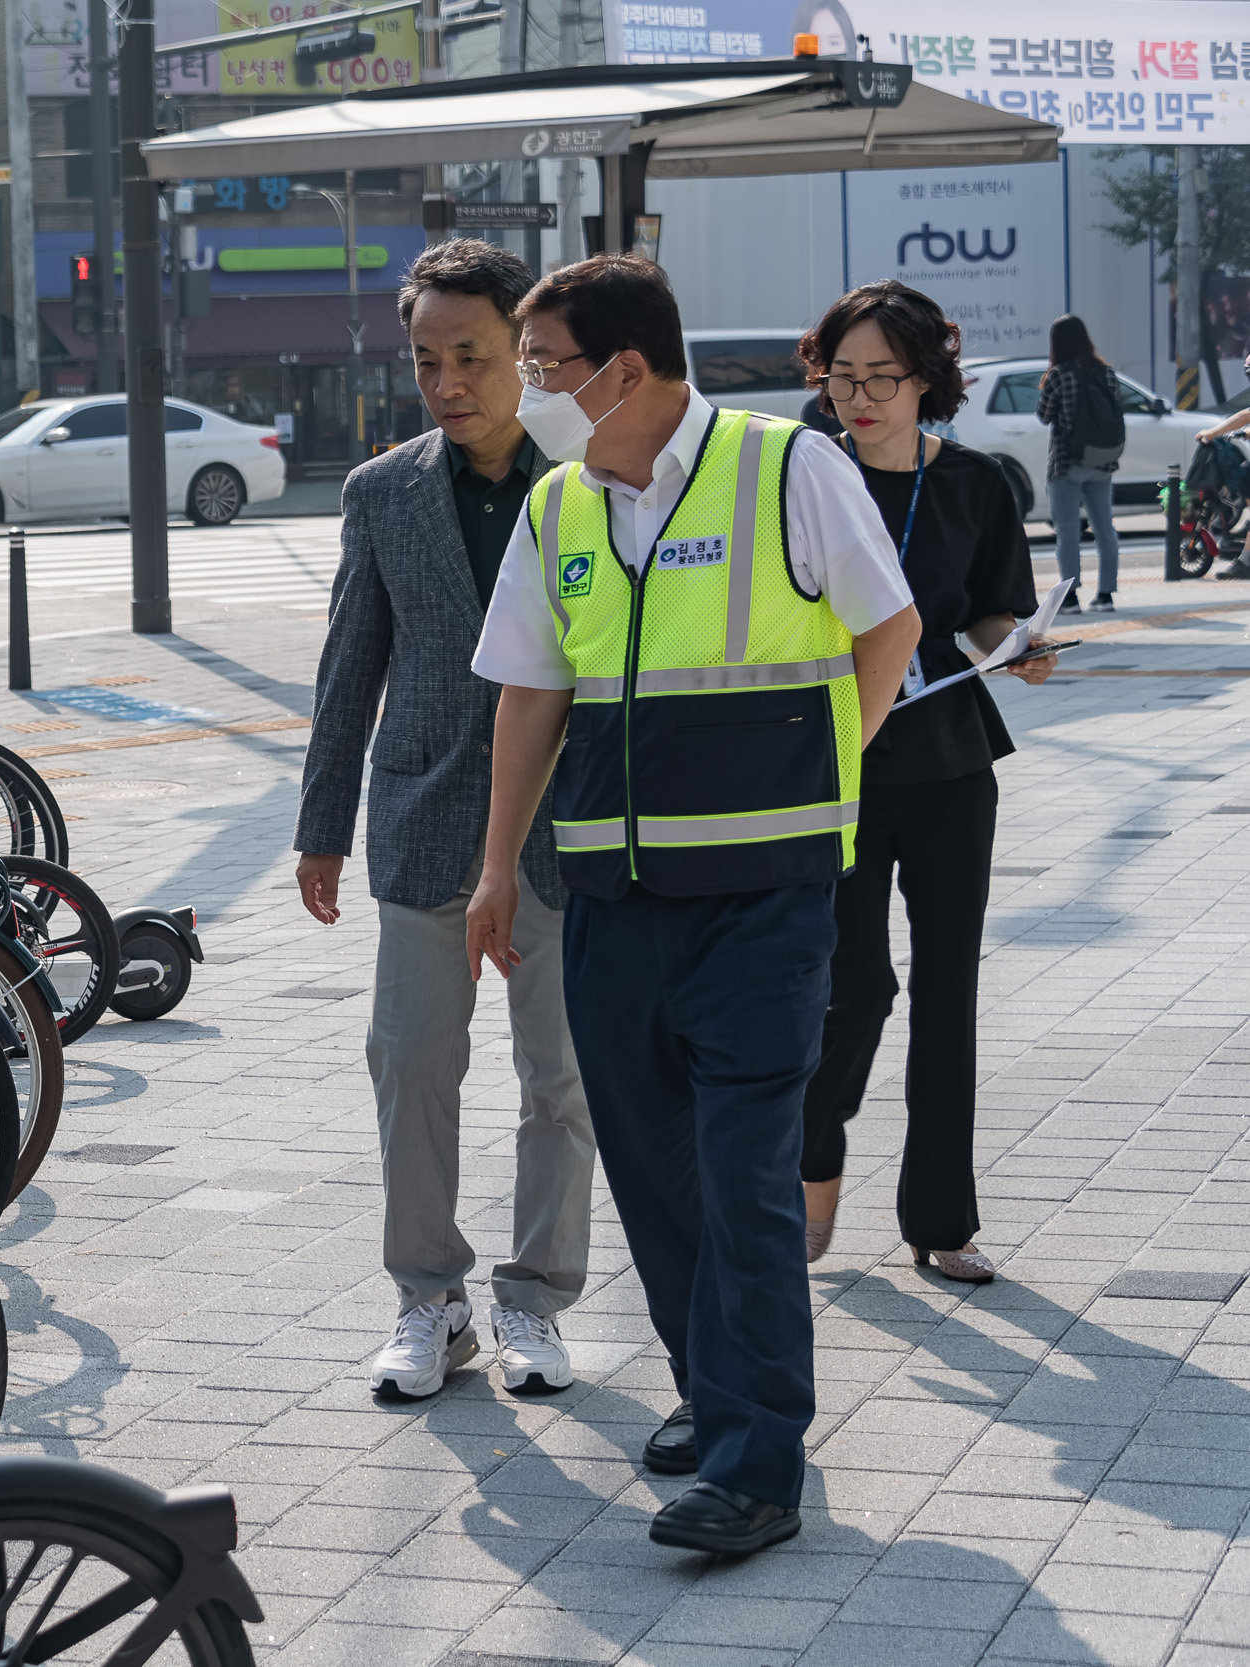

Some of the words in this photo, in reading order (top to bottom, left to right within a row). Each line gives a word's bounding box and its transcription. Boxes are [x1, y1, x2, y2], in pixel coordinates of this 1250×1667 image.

[554, 129, 602, 146] 광진구
[896, 270, 982, 282] Rainbowbridge
[983, 265, 1017, 277] World
[677, 551, 723, 565] 광진구청장
[561, 582, 588, 594] 광진구
